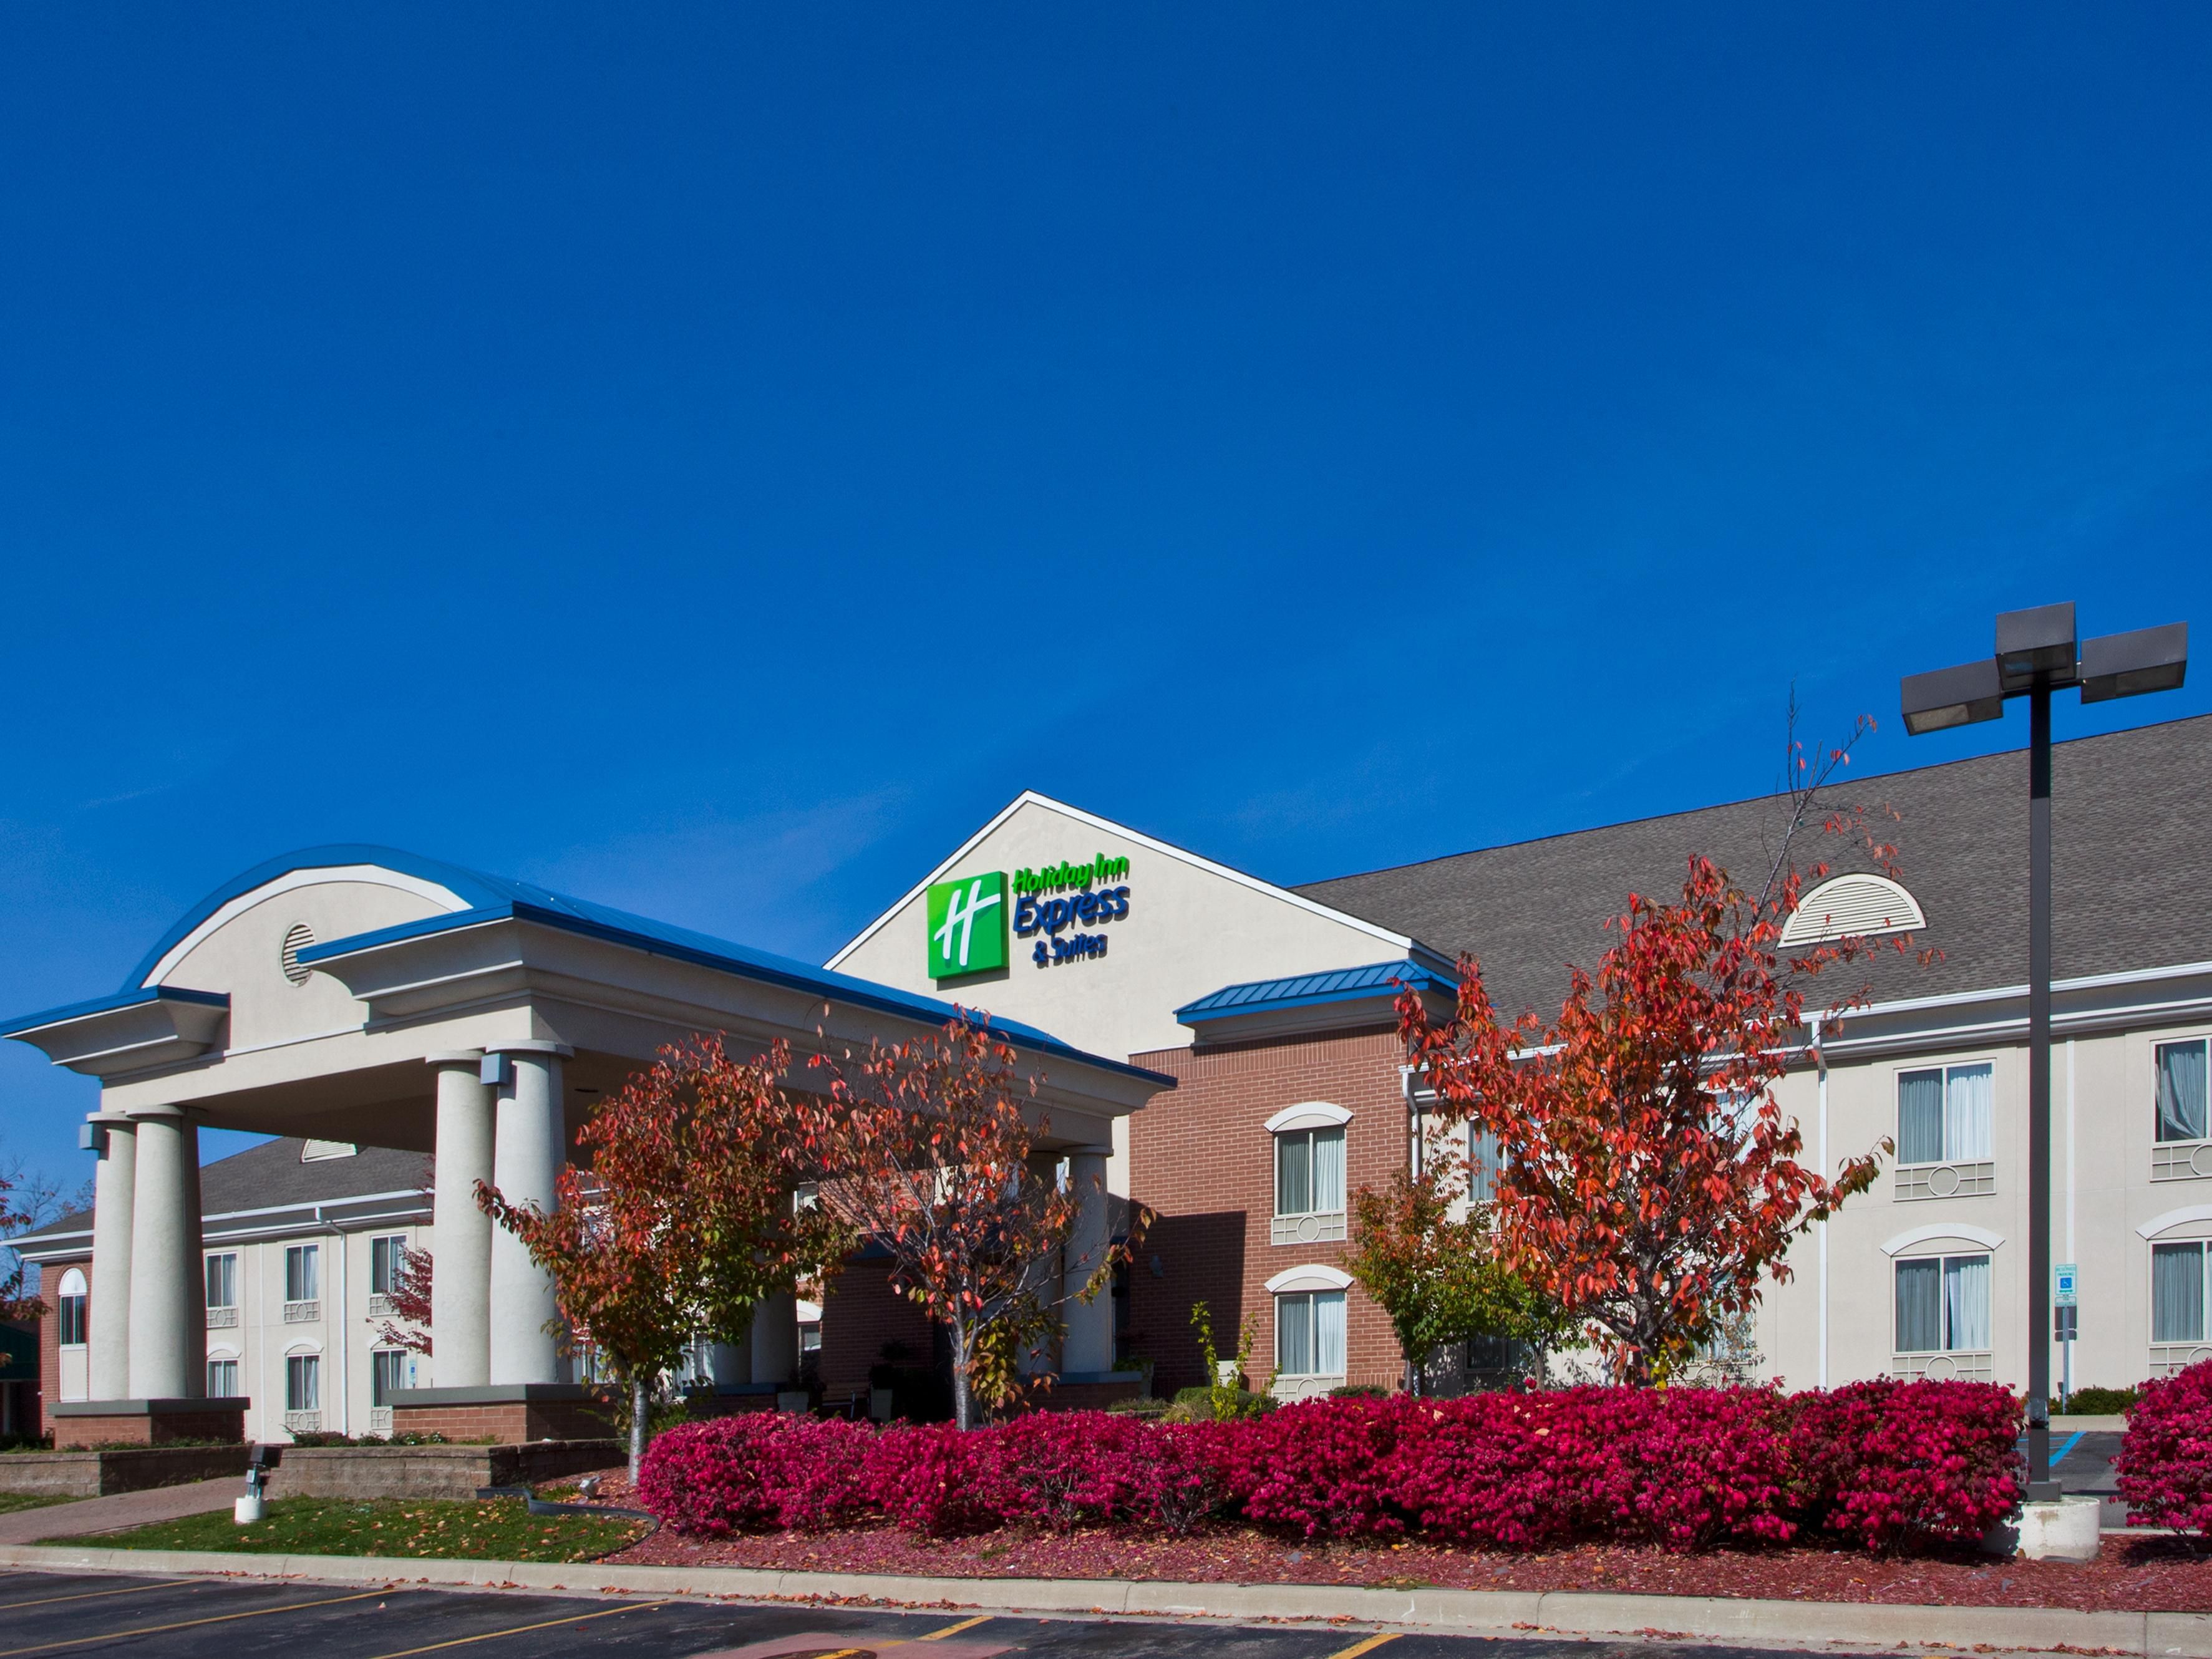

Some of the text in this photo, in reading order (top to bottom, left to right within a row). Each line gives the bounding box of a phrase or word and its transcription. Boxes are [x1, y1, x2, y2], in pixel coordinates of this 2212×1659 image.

[1012, 852, 1130, 894] Holiday Inn
[1012, 886, 1130, 936] Express
[1032, 933, 1108, 963] & Suites
